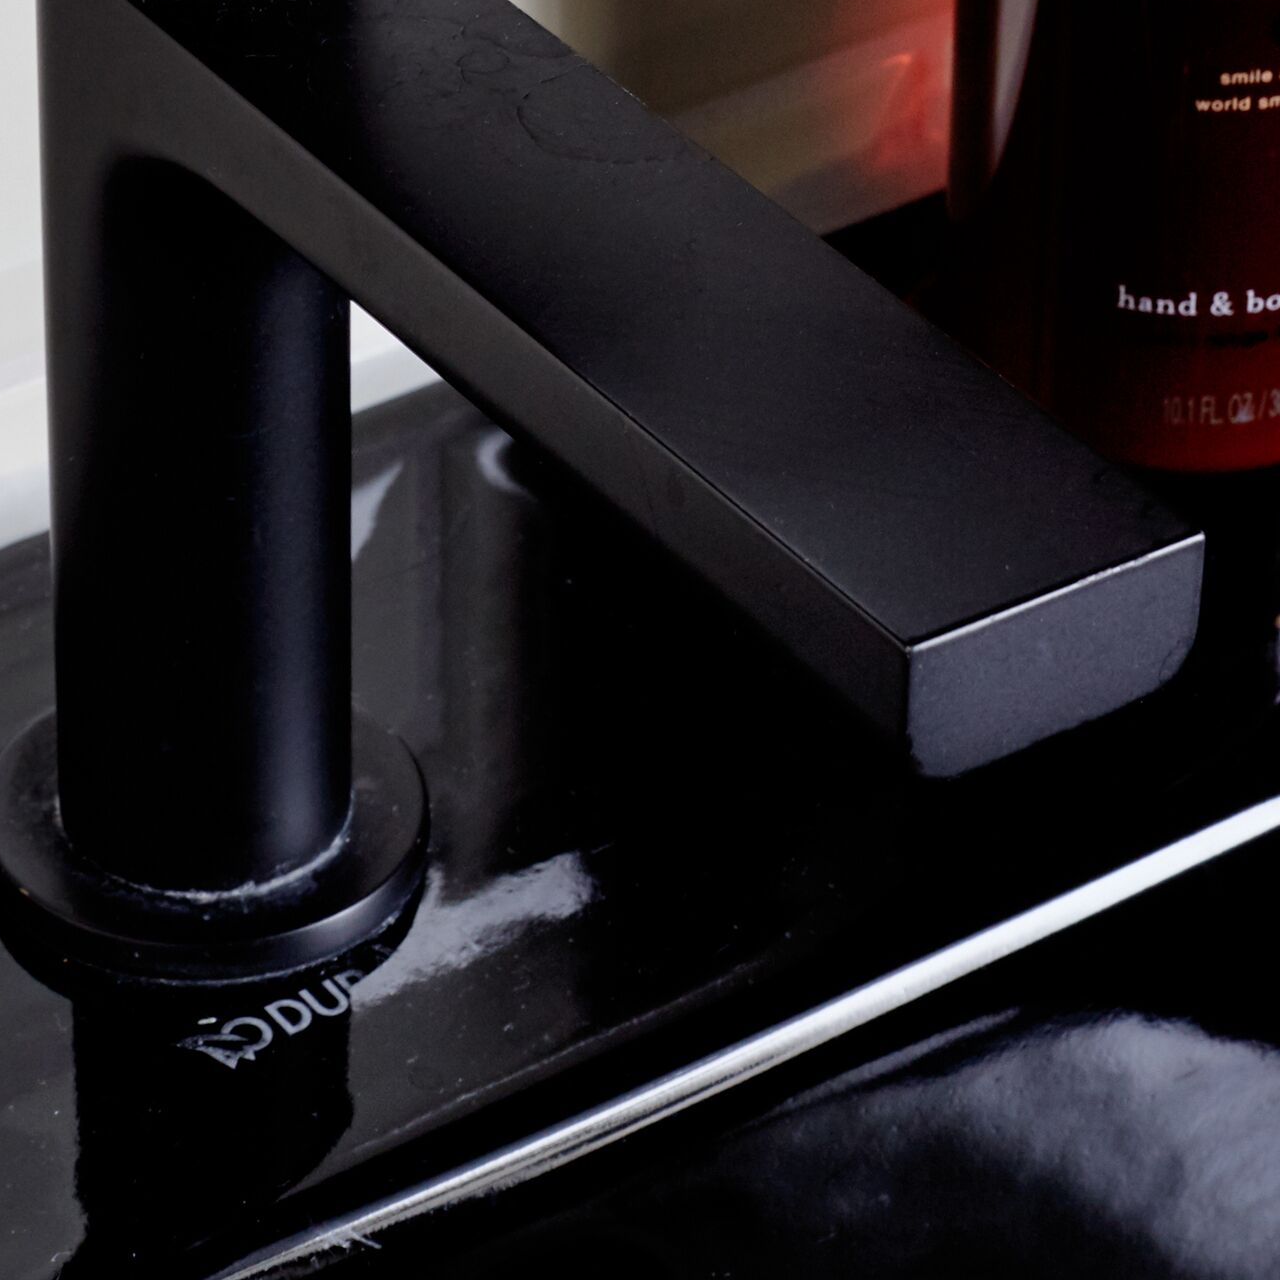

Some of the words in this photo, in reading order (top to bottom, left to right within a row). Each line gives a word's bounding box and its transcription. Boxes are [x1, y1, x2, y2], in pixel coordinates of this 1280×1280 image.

[1220, 68, 1274, 86] smile
[1195, 96, 1252, 113] world
[1116, 284, 1198, 317] hand
[1209, 291, 1235, 317] &
